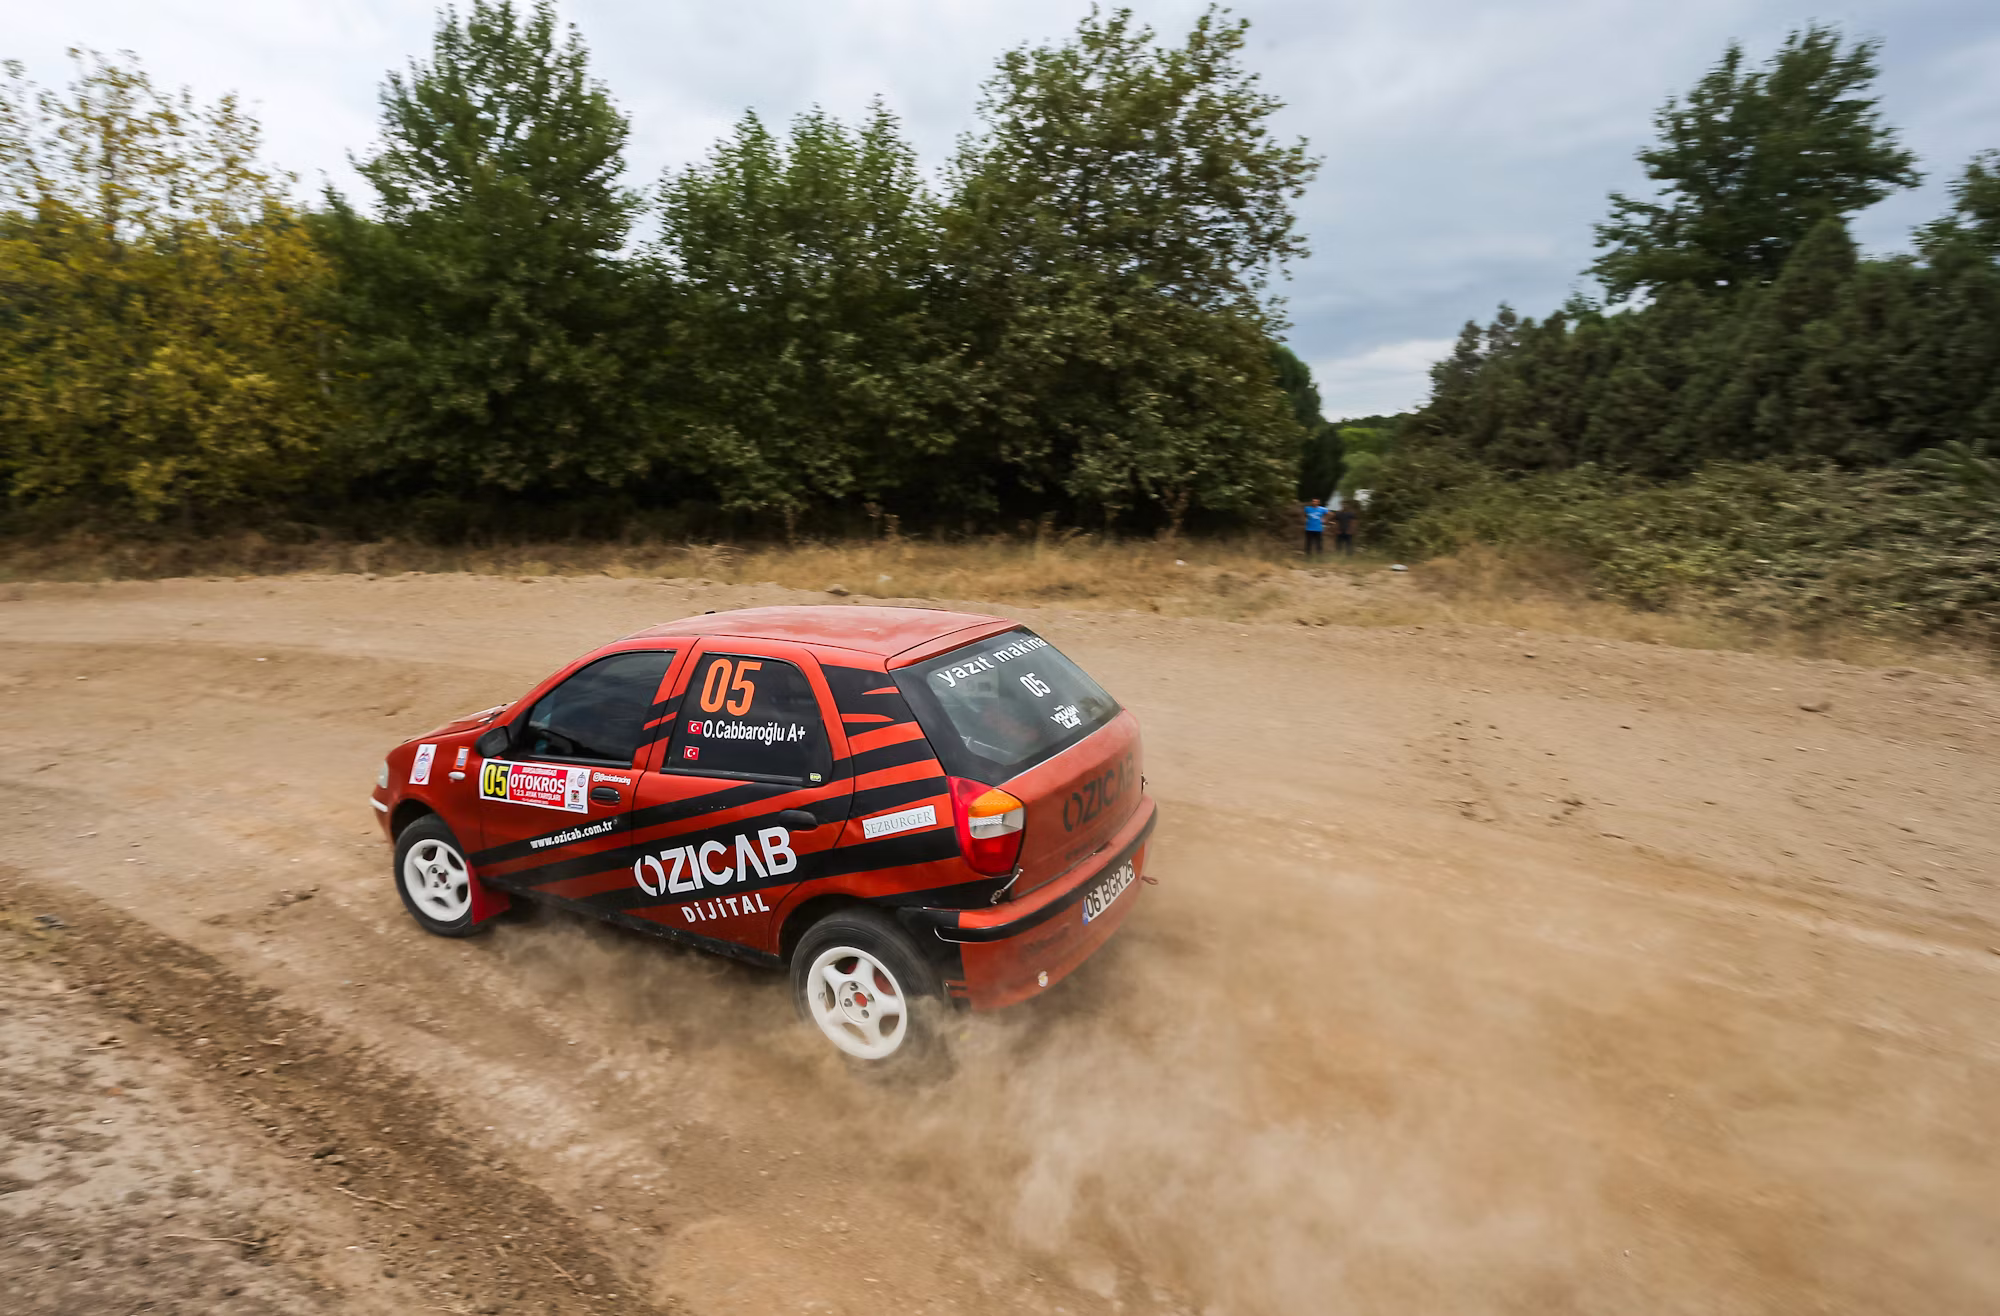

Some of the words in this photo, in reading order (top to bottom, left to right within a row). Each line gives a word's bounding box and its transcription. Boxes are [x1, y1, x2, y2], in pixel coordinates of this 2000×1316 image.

[992, 636, 1049, 663] makina
[700, 658, 762, 717] 05
[1019, 672, 1051, 698] 05
[702, 719, 786, 746] O.Cabbaroğlu
[786, 723, 806, 742] A+
[483, 763, 509, 797] 05
[510, 773, 566, 795] OTOKROS
[530, 820, 613, 849] www.ozicab.com.tr
[864, 811, 934, 836] SEZBURGER
[634, 826, 797, 897] OZICAB
[1086, 889, 1102, 918] 06
[1101, 869, 1124, 905] BGR
